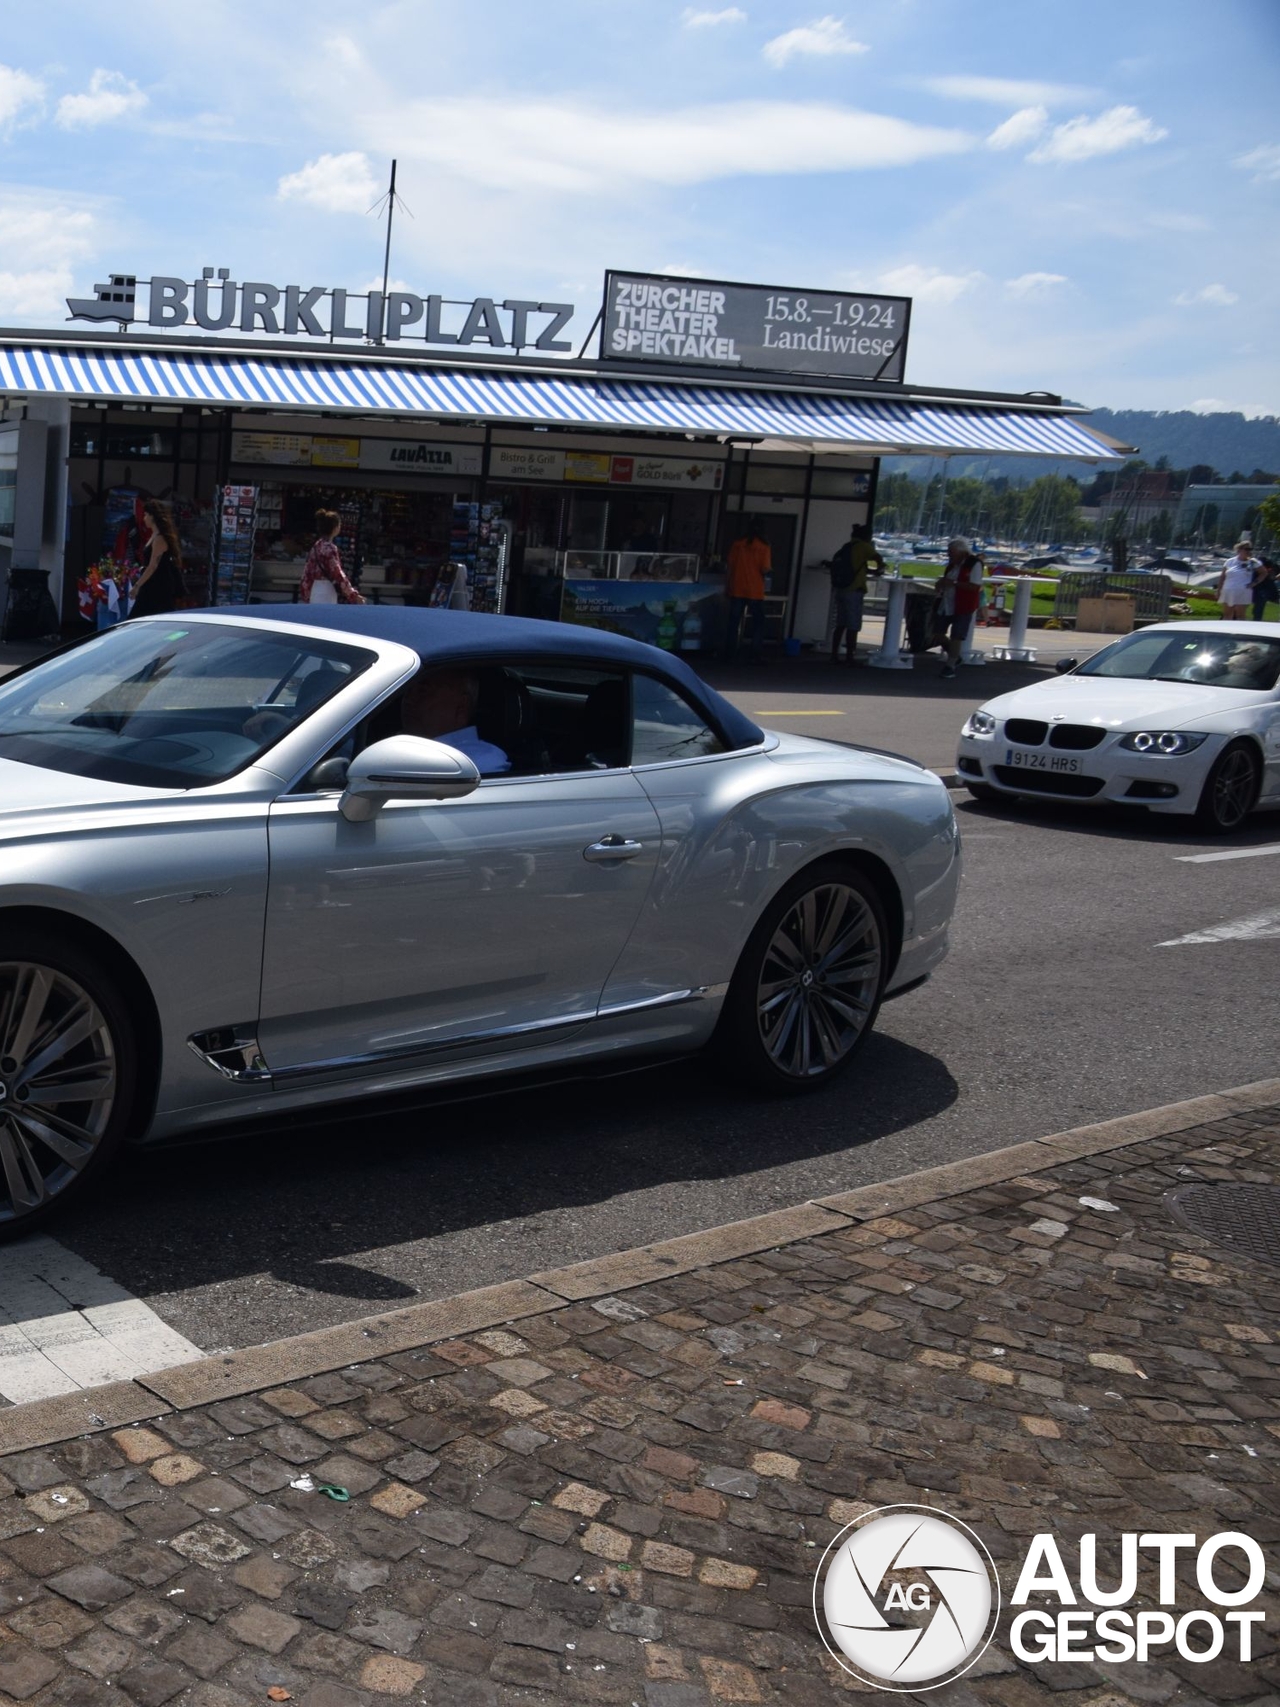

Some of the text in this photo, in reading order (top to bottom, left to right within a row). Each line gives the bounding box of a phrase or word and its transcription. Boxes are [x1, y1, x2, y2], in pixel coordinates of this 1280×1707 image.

[616, 282, 726, 314] ZÜRCHER
[149, 267, 574, 352] BÜRKLIPLATZ
[614, 304, 718, 337] THEATER
[611, 328, 741, 361] SPEKTAKEL
[762, 324, 895, 357] Landiwiese
[390, 444, 453, 465] LAVAZZA
[500, 452, 556, 464] Bistro & Grill
[511, 465, 545, 475] am See
[637, 470, 661, 480] GOLD
[852, 483, 869, 493] WC
[1014, 752, 1078, 772] 9124 HRS
